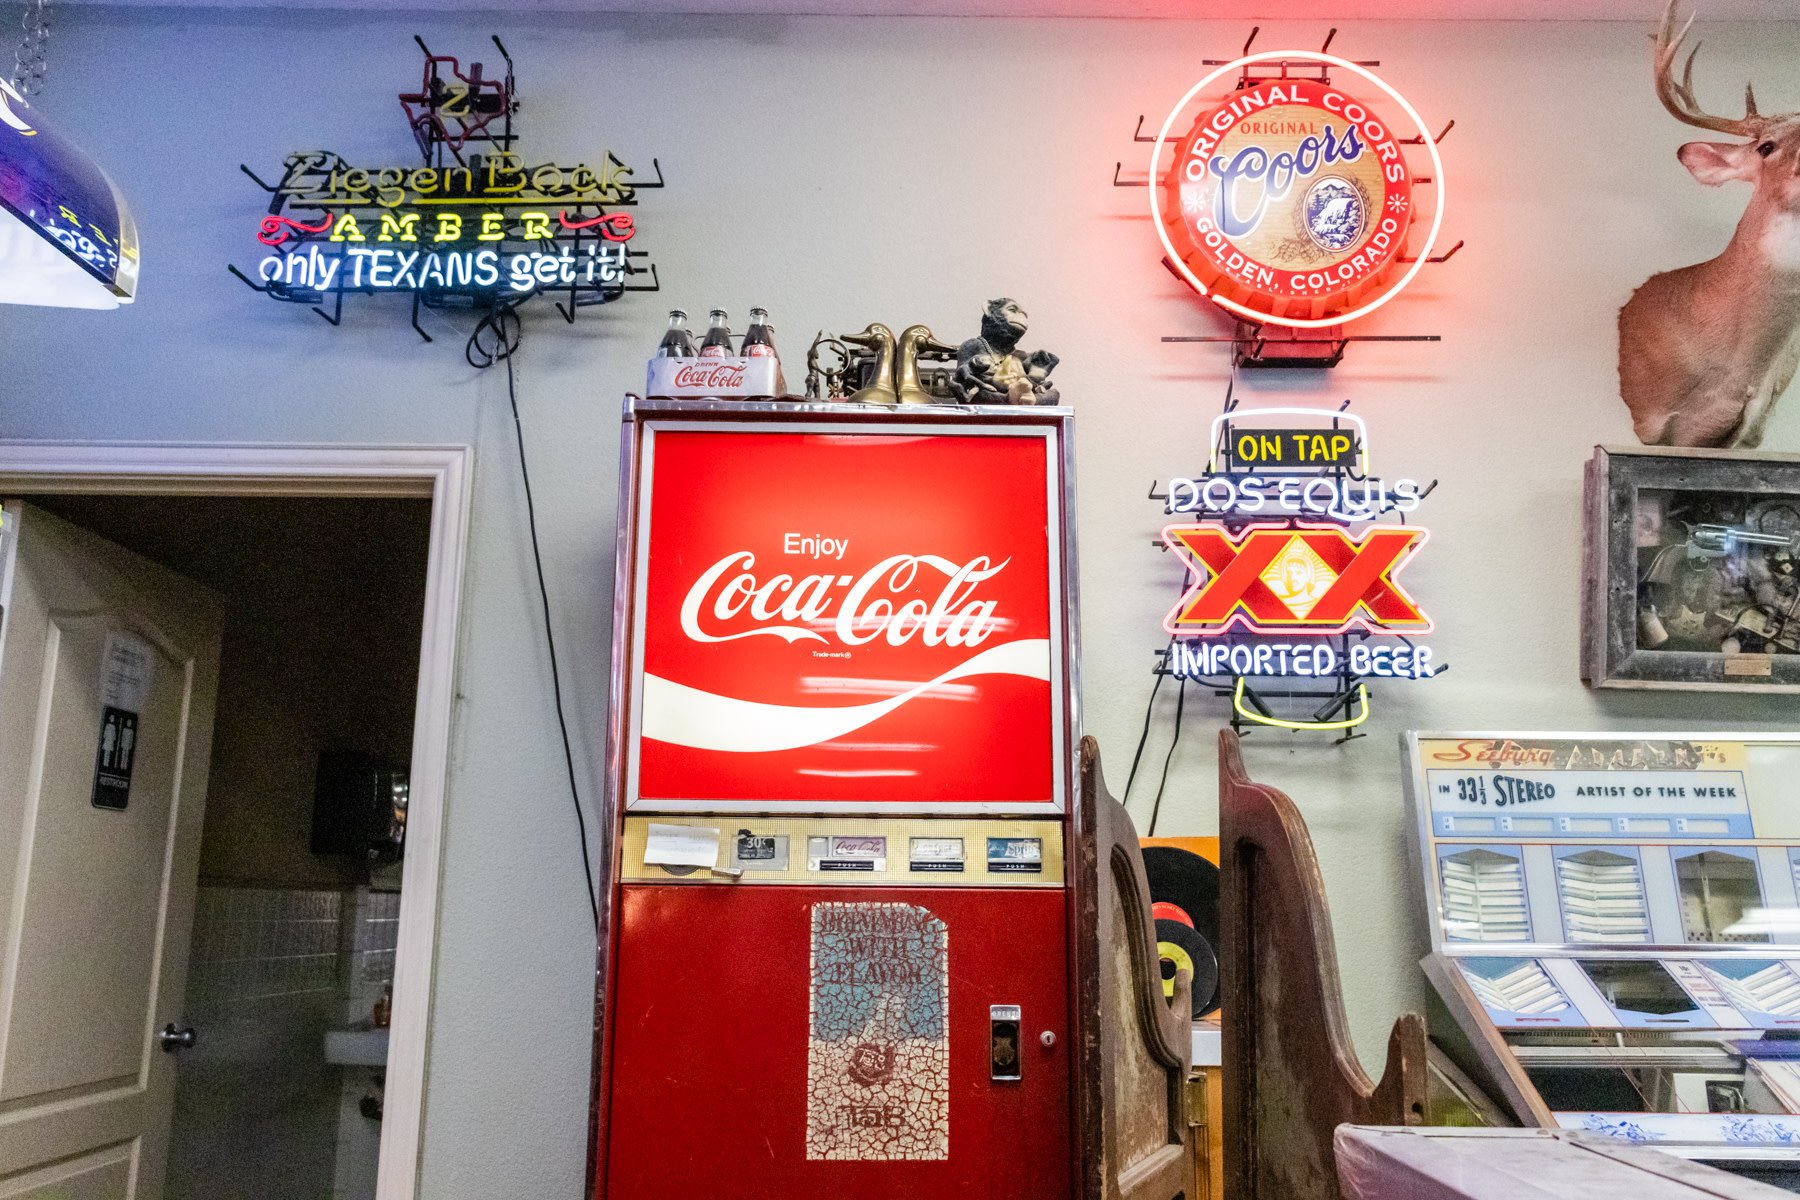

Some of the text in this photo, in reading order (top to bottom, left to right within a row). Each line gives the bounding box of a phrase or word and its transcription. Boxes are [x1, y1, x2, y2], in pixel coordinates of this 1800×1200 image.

[1186, 85, 1405, 183] ORIGINAL COORS
[1240, 122, 1318, 135] ORIGINAL
[1208, 123, 1365, 239] Coors
[329, 212, 554, 243] AMBER
[259, 243, 626, 291] only TEXANS get it!
[1196, 217, 1398, 290] GOLDEN, COLORADO
[674, 365, 748, 388] Coca-Cola
[1238, 434, 1351, 461] ON TAP
[1168, 477, 1421, 521] DOS EQUIS
[784, 532, 849, 560] Enjoy
[1170, 529, 1428, 625] XX
[680, 550, 1012, 648] Coca-Cola
[1171, 643, 1435, 678] IMPORTED BEER
[1433, 739, 1552, 767] Seeburg
[1438, 784, 1451, 793] IN
[1492, 774, 1556, 807] STEREO
[1576, 786, 1626, 797] ARTIST
[1633, 786, 1651, 797] OF
[1658, 787, 1686, 798] THE
[1693, 787, 1737, 798] WEEK
